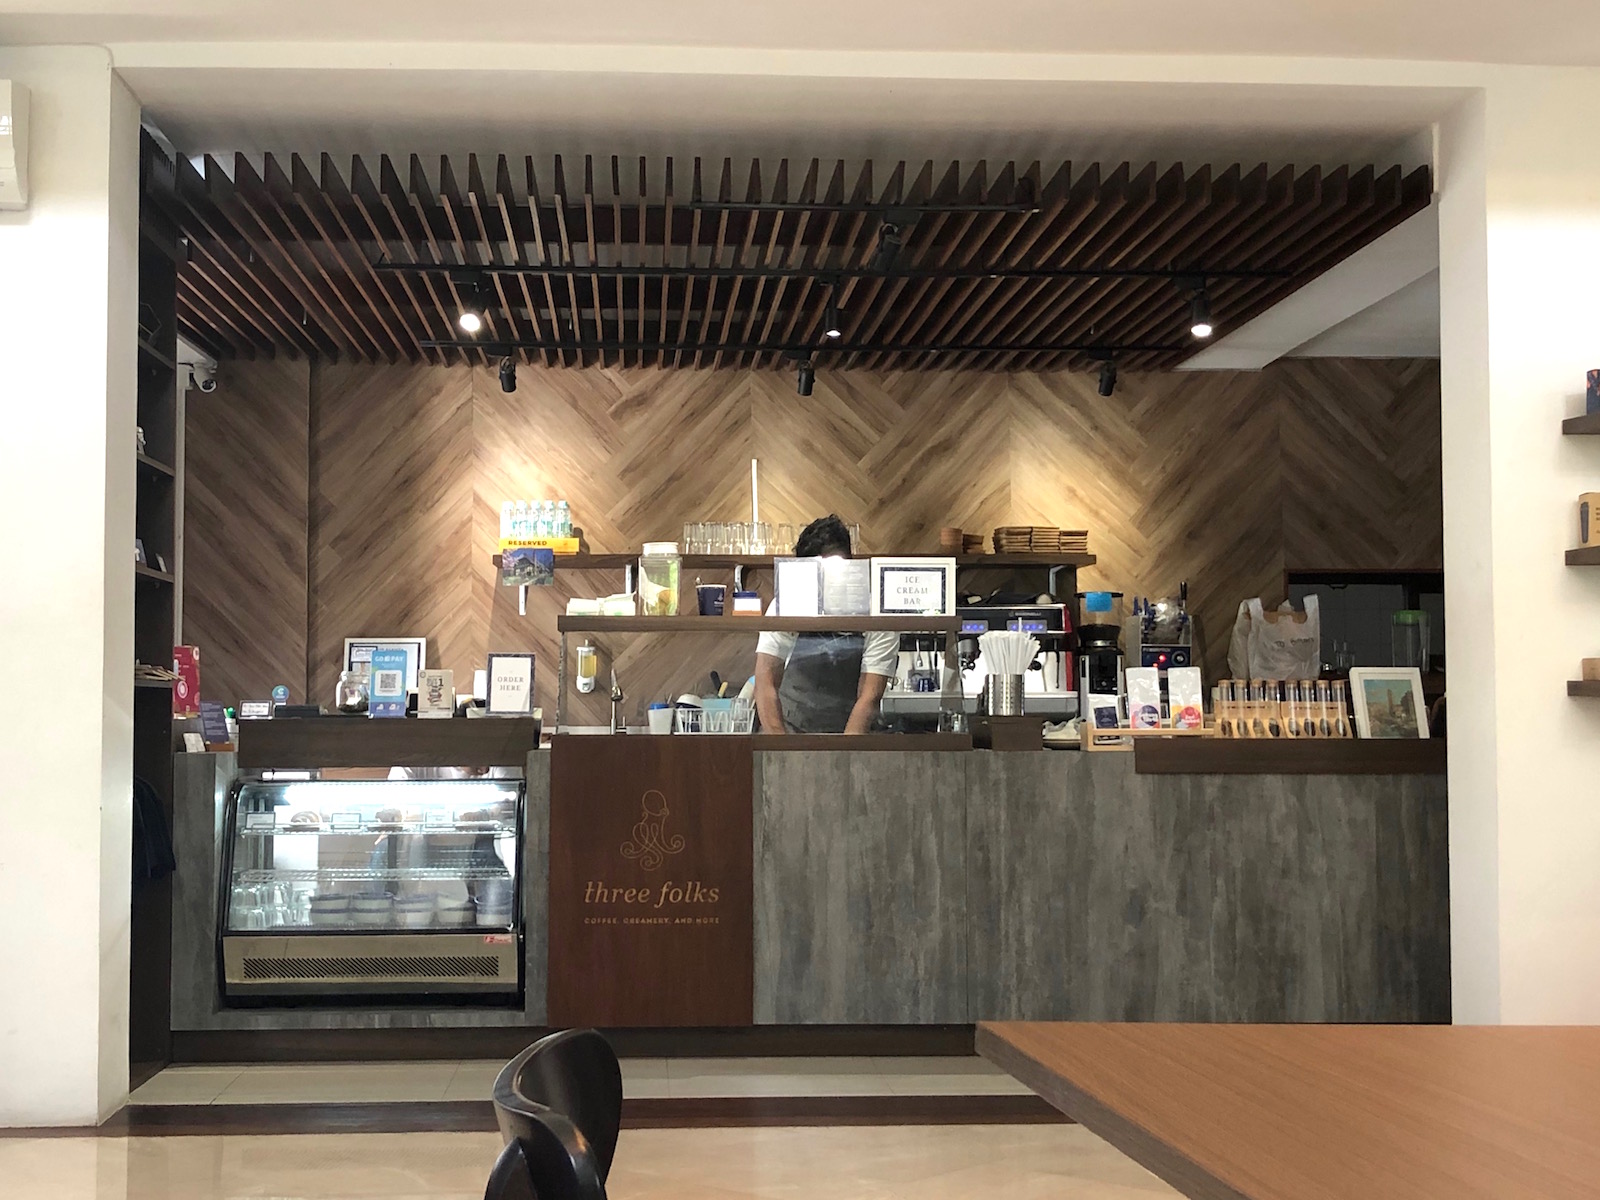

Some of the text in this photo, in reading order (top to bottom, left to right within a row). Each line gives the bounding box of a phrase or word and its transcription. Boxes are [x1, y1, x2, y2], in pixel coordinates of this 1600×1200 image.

[896, 586, 928, 594] CREAM
[903, 597, 921, 605] BAR
[584, 881, 720, 909] three folks
[674, 917, 692, 925] AND
[695, 917, 720, 925] MORE
